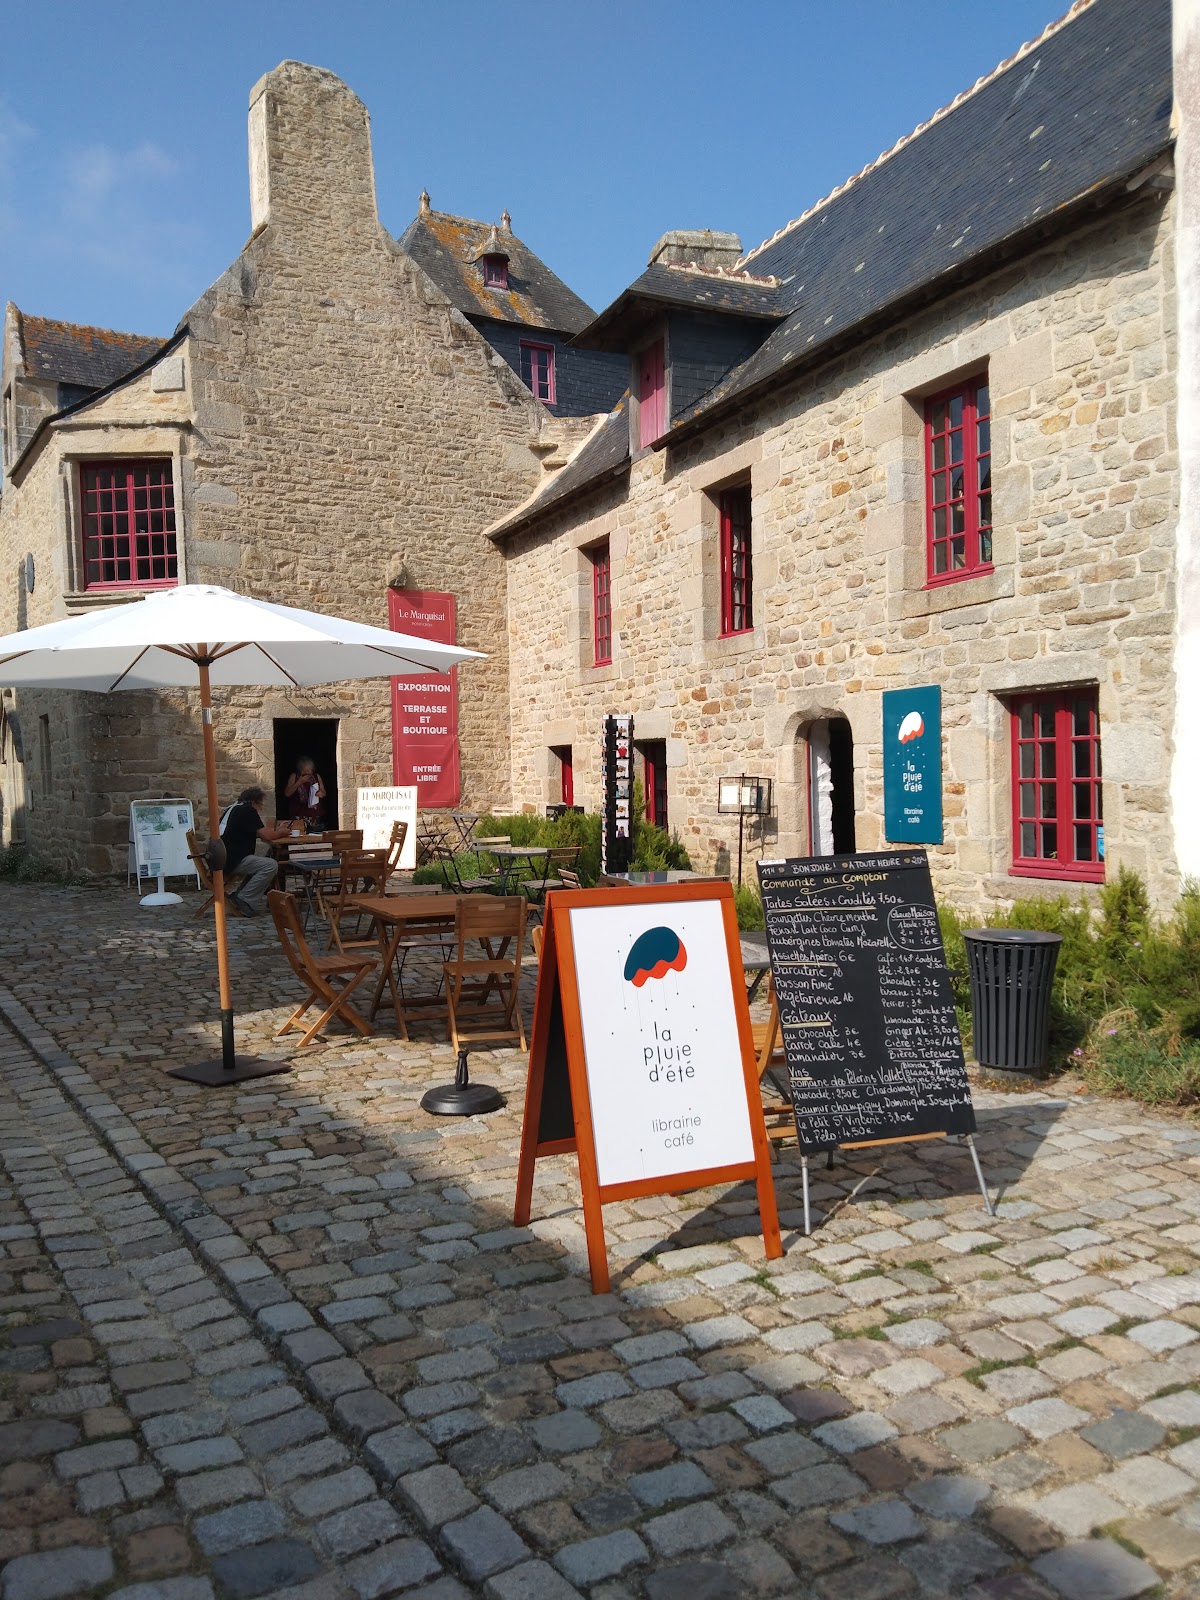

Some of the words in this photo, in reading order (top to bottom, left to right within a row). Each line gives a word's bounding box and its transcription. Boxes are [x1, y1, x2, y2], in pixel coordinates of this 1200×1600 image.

[399, 609, 408, 618] Le
[410, 610, 445, 622] Marquisat
[398, 683, 450, 692] EXPOSITION
[403, 704, 447, 714] TERRASSE
[420, 716, 430, 724] ET
[403, 726, 448, 735] BOUTIQUE
[412, 764, 442, 773] ENTRÉE
[907, 760, 915, 771] la
[416, 774, 438, 782] LIBRE
[903, 772, 922, 782] pluie
[904, 780, 922, 792] d'été
[855, 860, 876, 869] TOUTE
[877, 858, 901, 867] HEURE
[762, 878, 816, 890] Commande
[842, 872, 890, 886] Comptoir
[762, 896, 792, 909] Tartes
[794, 894, 830, 907] Salées
[838, 891, 877, 905] Crudités
[766, 912, 812, 925] Courgettes
[772, 964, 827, 977] Charcuterie
[774, 976, 809, 990] Poisson
[654, 1022, 672, 1042] la
[784, 1032, 797, 1040] au
[798, 1026, 840, 1040] Chocolat
[886, 1026, 912, 1040] Ginger
[785, 1040, 816, 1050] Carrot
[818, 1036, 845, 1049] Cake
[644, 1044, 692, 1066] pluie
[888, 1050, 918, 1060] Bières
[649, 1060, 696, 1083] d'été
[788, 1066, 810, 1078] Vins
[790, 1079, 830, 1088] Domaine
[794, 1104, 829, 1115] Saumur
[926, 1093, 962, 1112] Joseph
[652, 1114, 702, 1132] librairie
[808, 1116, 830, 1128] Petit
[664, 1132, 694, 1149] café
